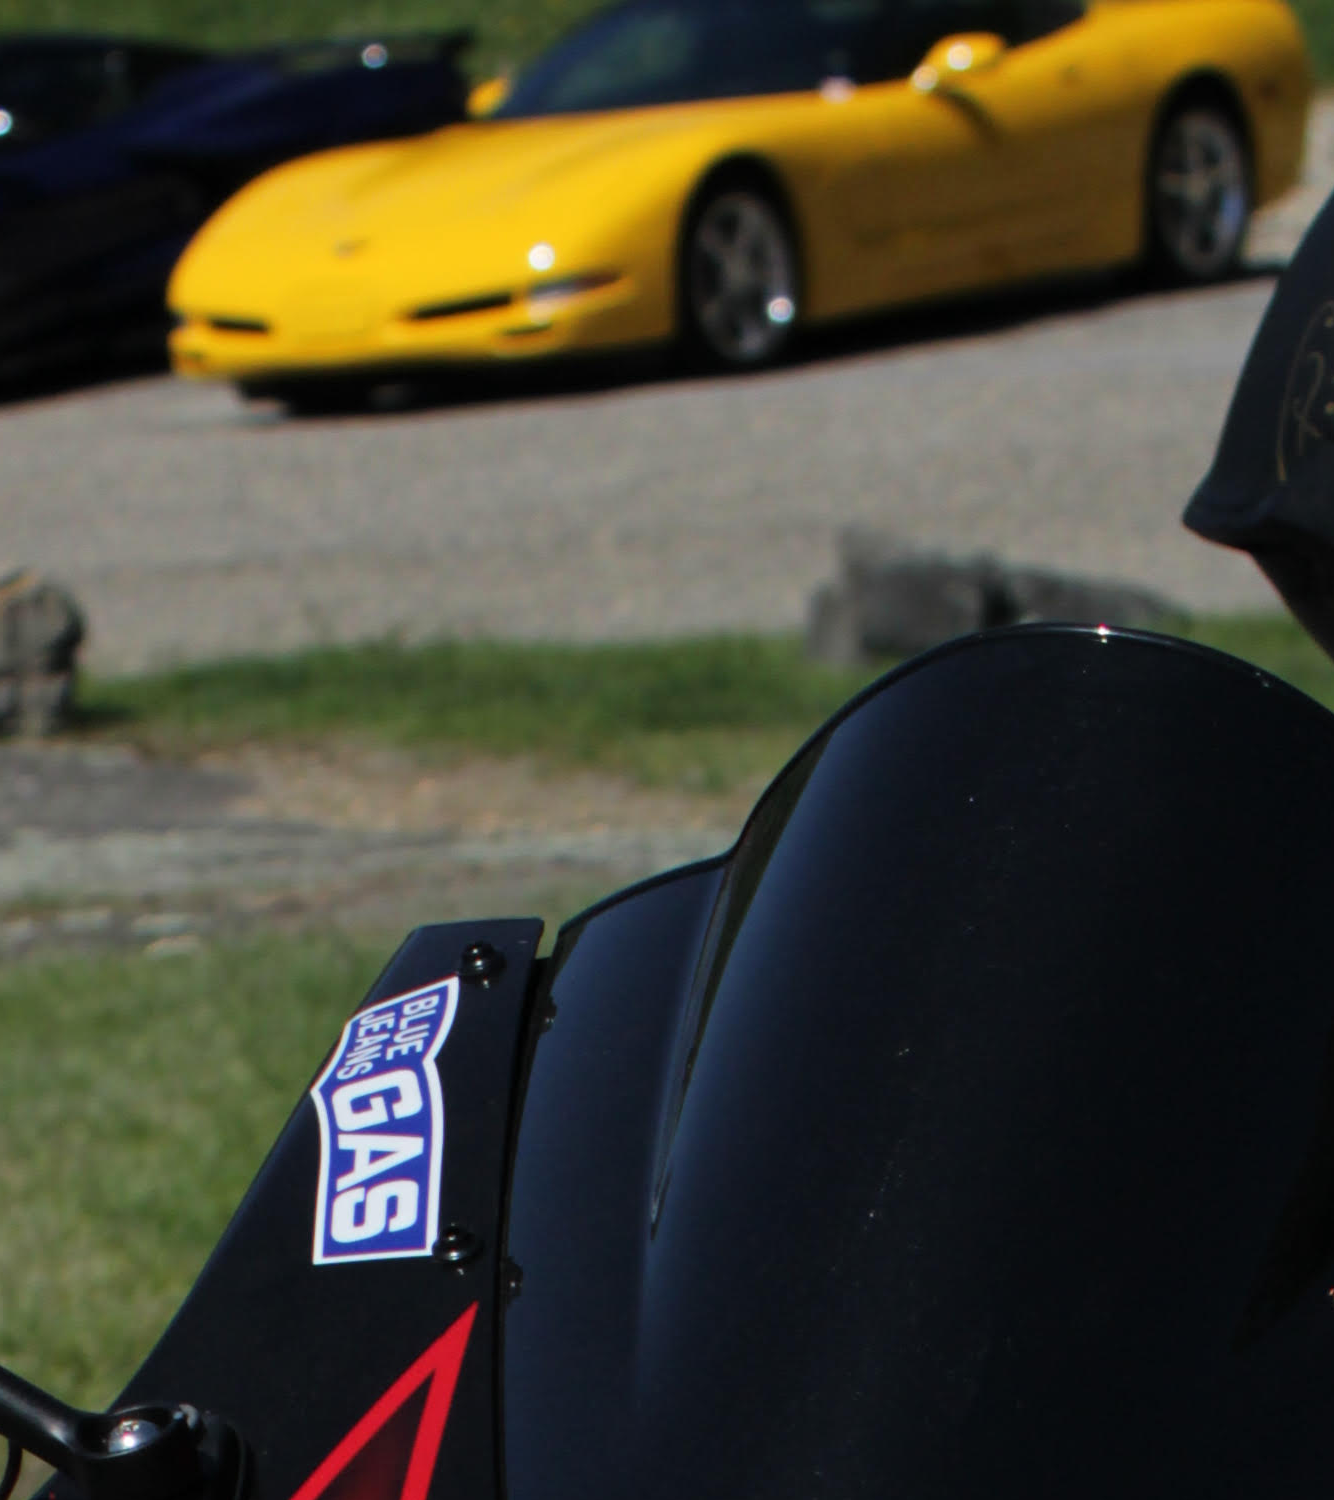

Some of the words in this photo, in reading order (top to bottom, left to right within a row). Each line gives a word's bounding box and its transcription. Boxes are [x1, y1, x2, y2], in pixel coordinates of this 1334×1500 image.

[336, 1010, 396, 1081] JEANS
[385, 993, 440, 1061] BLUE
[330, 1068, 424, 1244] GAS
